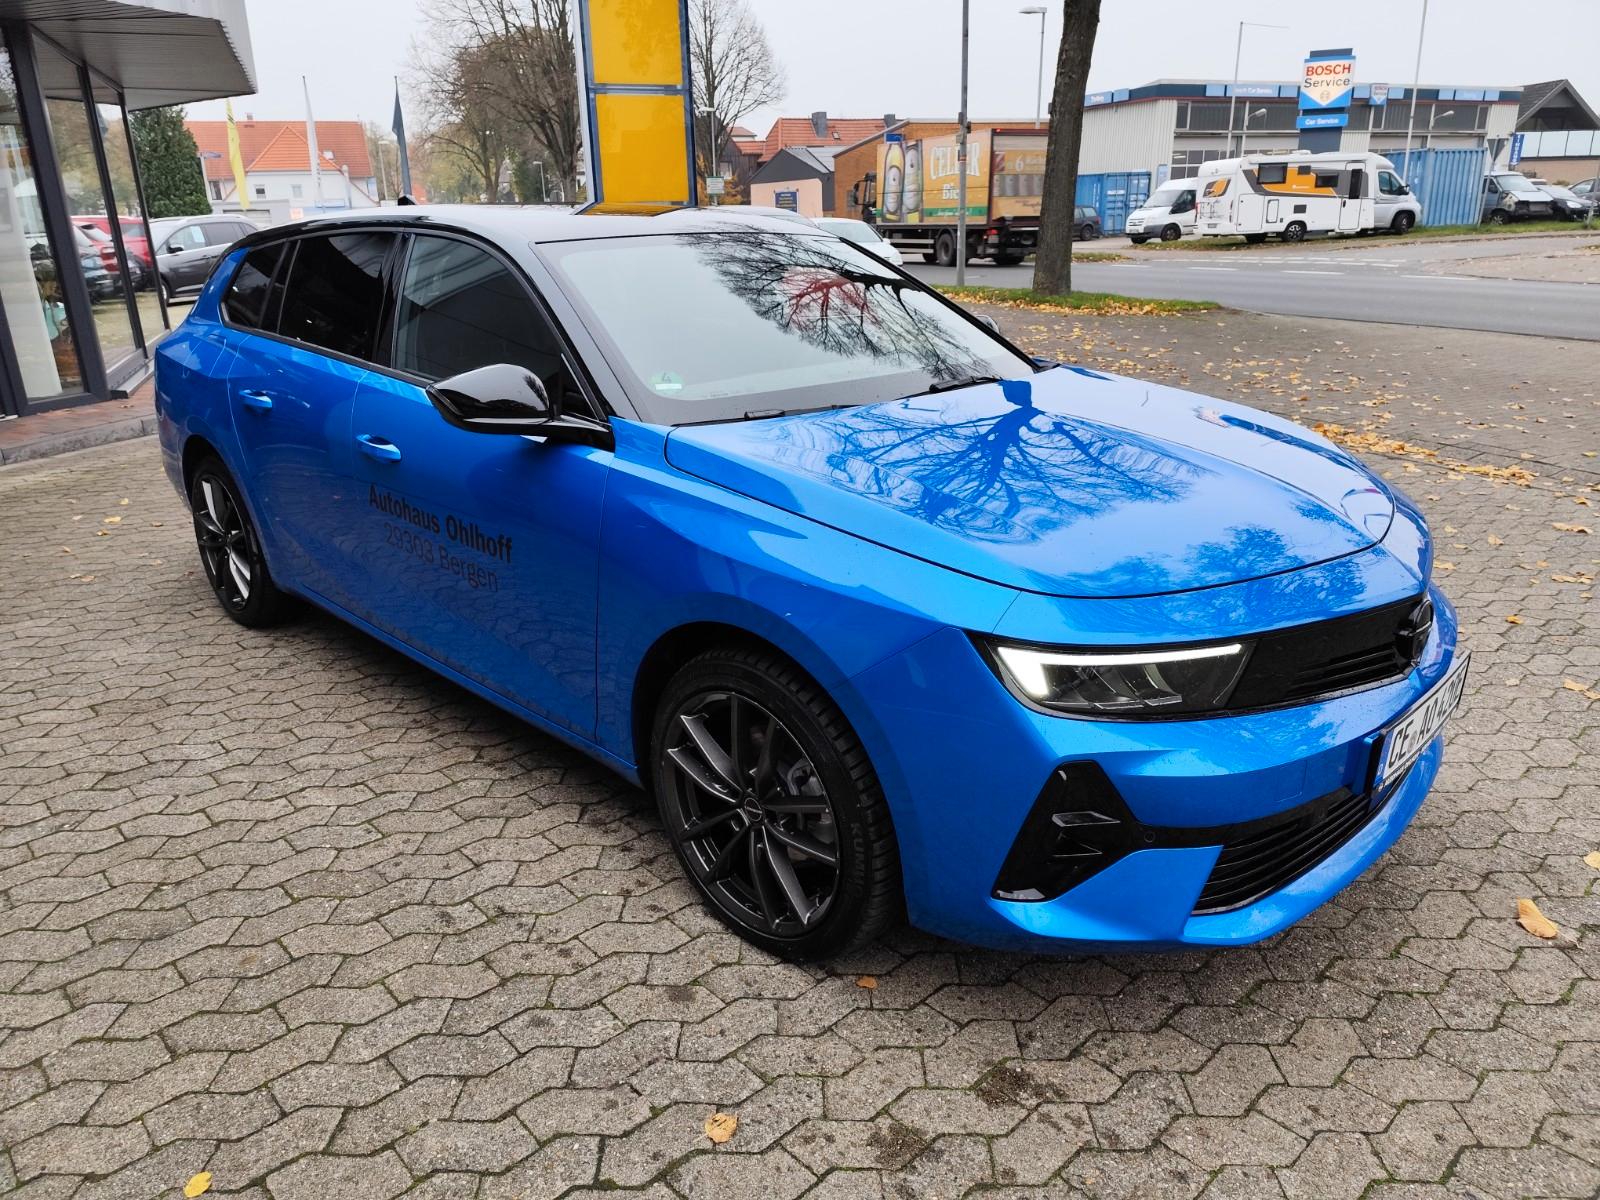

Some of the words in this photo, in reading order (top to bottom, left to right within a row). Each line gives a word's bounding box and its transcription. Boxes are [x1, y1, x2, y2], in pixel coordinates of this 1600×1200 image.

[1306, 63, 1352, 77] BOSCH
[1304, 78, 1351, 89] Service
[1305, 118, 1316, 126] Car
[943, 182, 961, 200] Bie
[369, 483, 440, 534] Autohaus
[446, 514, 513, 563] Ohlhoff
[439, 545, 498, 592] Bergen
[1389, 719, 1414, 768] CE
